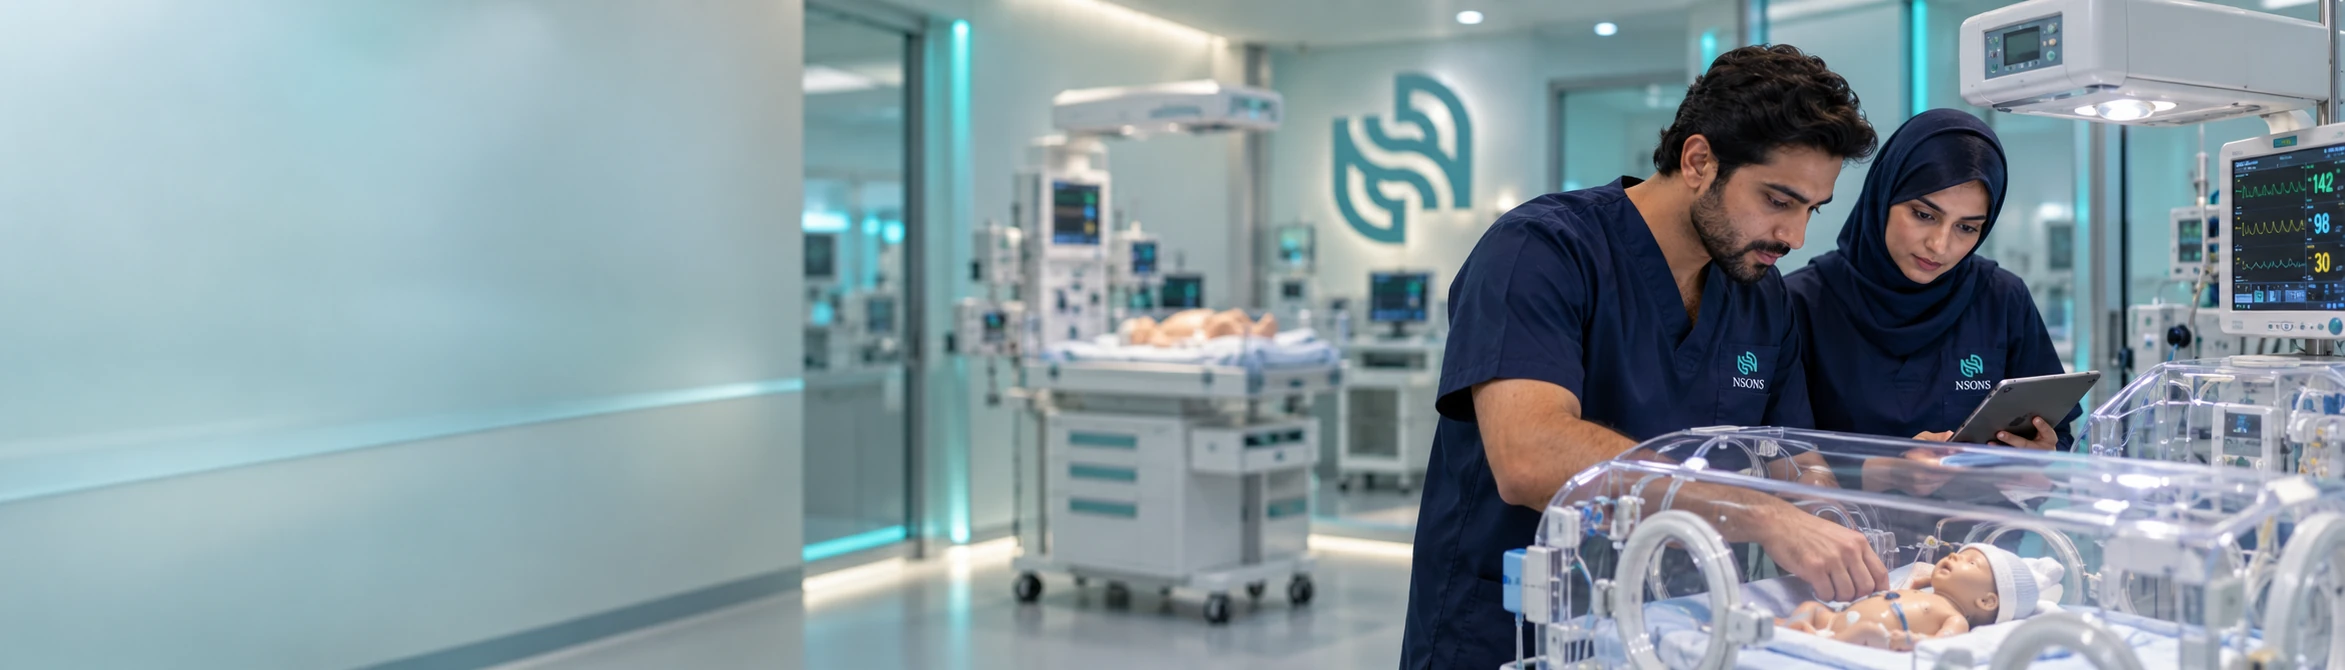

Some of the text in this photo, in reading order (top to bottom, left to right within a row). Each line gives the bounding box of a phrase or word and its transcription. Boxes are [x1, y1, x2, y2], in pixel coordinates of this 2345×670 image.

[2313, 171, 2334, 194] 142
[2314, 212, 2330, 234] 98
[2314, 252, 2330, 273] 30
[1732, 376, 1765, 390] NSONS
[1955, 380, 1991, 391] NSONS
